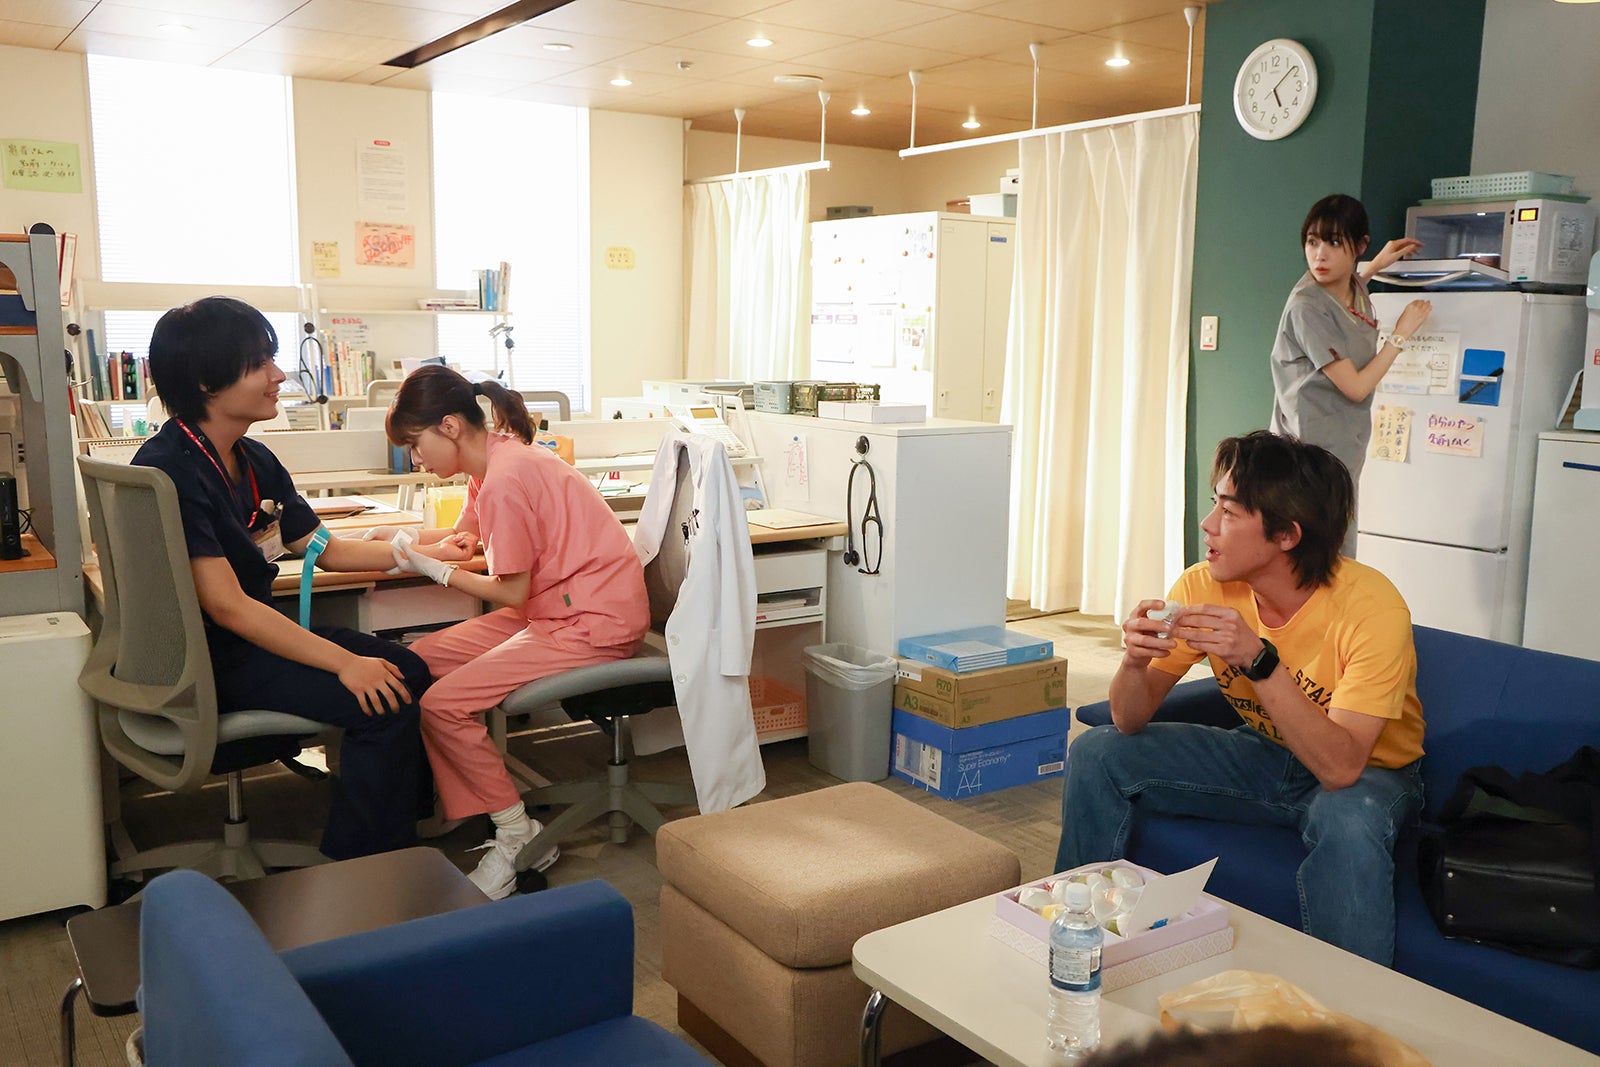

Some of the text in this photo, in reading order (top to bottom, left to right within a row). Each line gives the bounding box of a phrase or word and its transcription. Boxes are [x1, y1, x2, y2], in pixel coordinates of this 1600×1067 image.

[1260, 62, 1268, 72] 11
[1271, 55, 1281, 67] 12
[1252, 73, 1261, 84] 10
[1296, 80, 1303, 92] 3
[1248, 88, 1255, 98] 9
[1292, 96, 1299, 106] 4
[1252, 102, 1258, 113] 8
[1283, 108, 1290, 119] 5
[1270, 113, 1278, 125] 6
[1428, 413, 1475, 431] 自分のやつ
[1428, 433, 1472, 447] 名前かく
[936, 678, 952, 693] R70
[903, 693, 919, 711] A3
[958, 762, 977, 773] Super
[955, 769, 983, 796] A4
